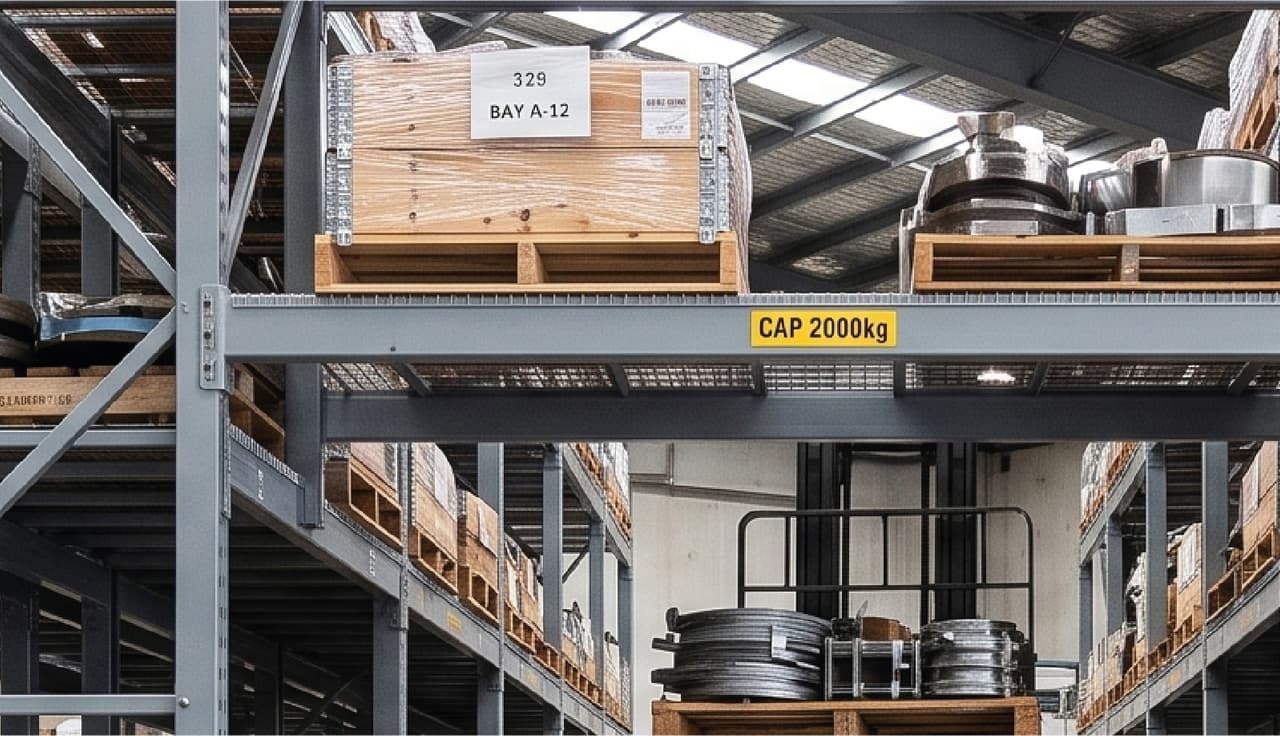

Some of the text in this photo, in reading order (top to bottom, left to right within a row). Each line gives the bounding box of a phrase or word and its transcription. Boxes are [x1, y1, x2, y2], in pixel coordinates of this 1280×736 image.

[513, 72, 547, 88] 329
[490, 103, 570, 119] BAY A-12
[759, 317, 889, 344] CAP 2000kg
